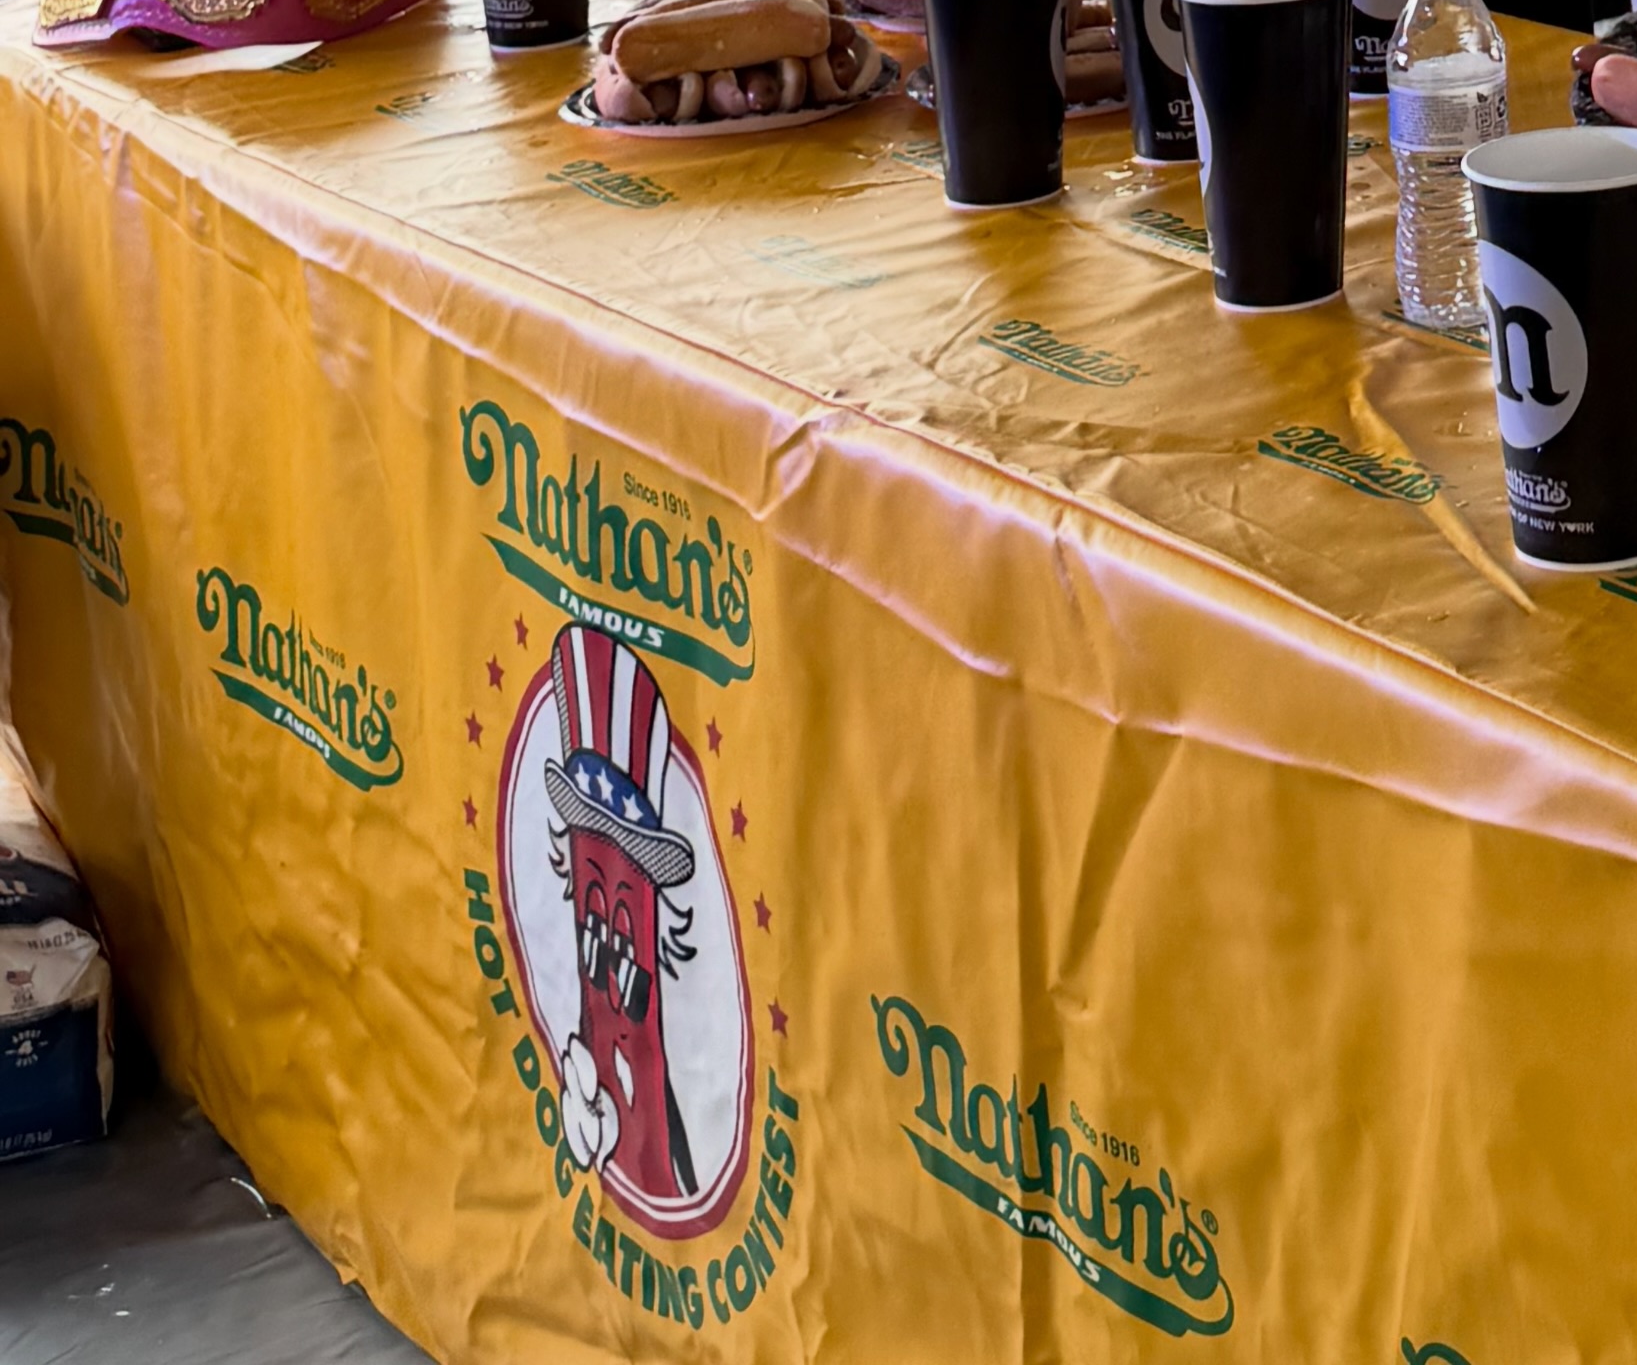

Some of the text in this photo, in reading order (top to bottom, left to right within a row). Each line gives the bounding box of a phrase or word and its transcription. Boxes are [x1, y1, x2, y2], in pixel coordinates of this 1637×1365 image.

[459, 399, 754, 649] Nathan's
[623, 471, 693, 521] Since 1916
[1530, 517, 1557, 532] NEW
[196, 566, 402, 763] Nathan's
[557, 584, 665, 649] FAMOUS
[462, 867, 524, 1022] HOT
[511, 1032, 577, 1199] DOG
[871, 993, 1234, 1303] Nathan's
[1100, 1130, 1142, 1168] 1916
[571, 1183, 707, 1332] EATING
[706, 1066, 802, 1325] CONTEST
[996, 1197, 1102, 1284] FAMOUS
